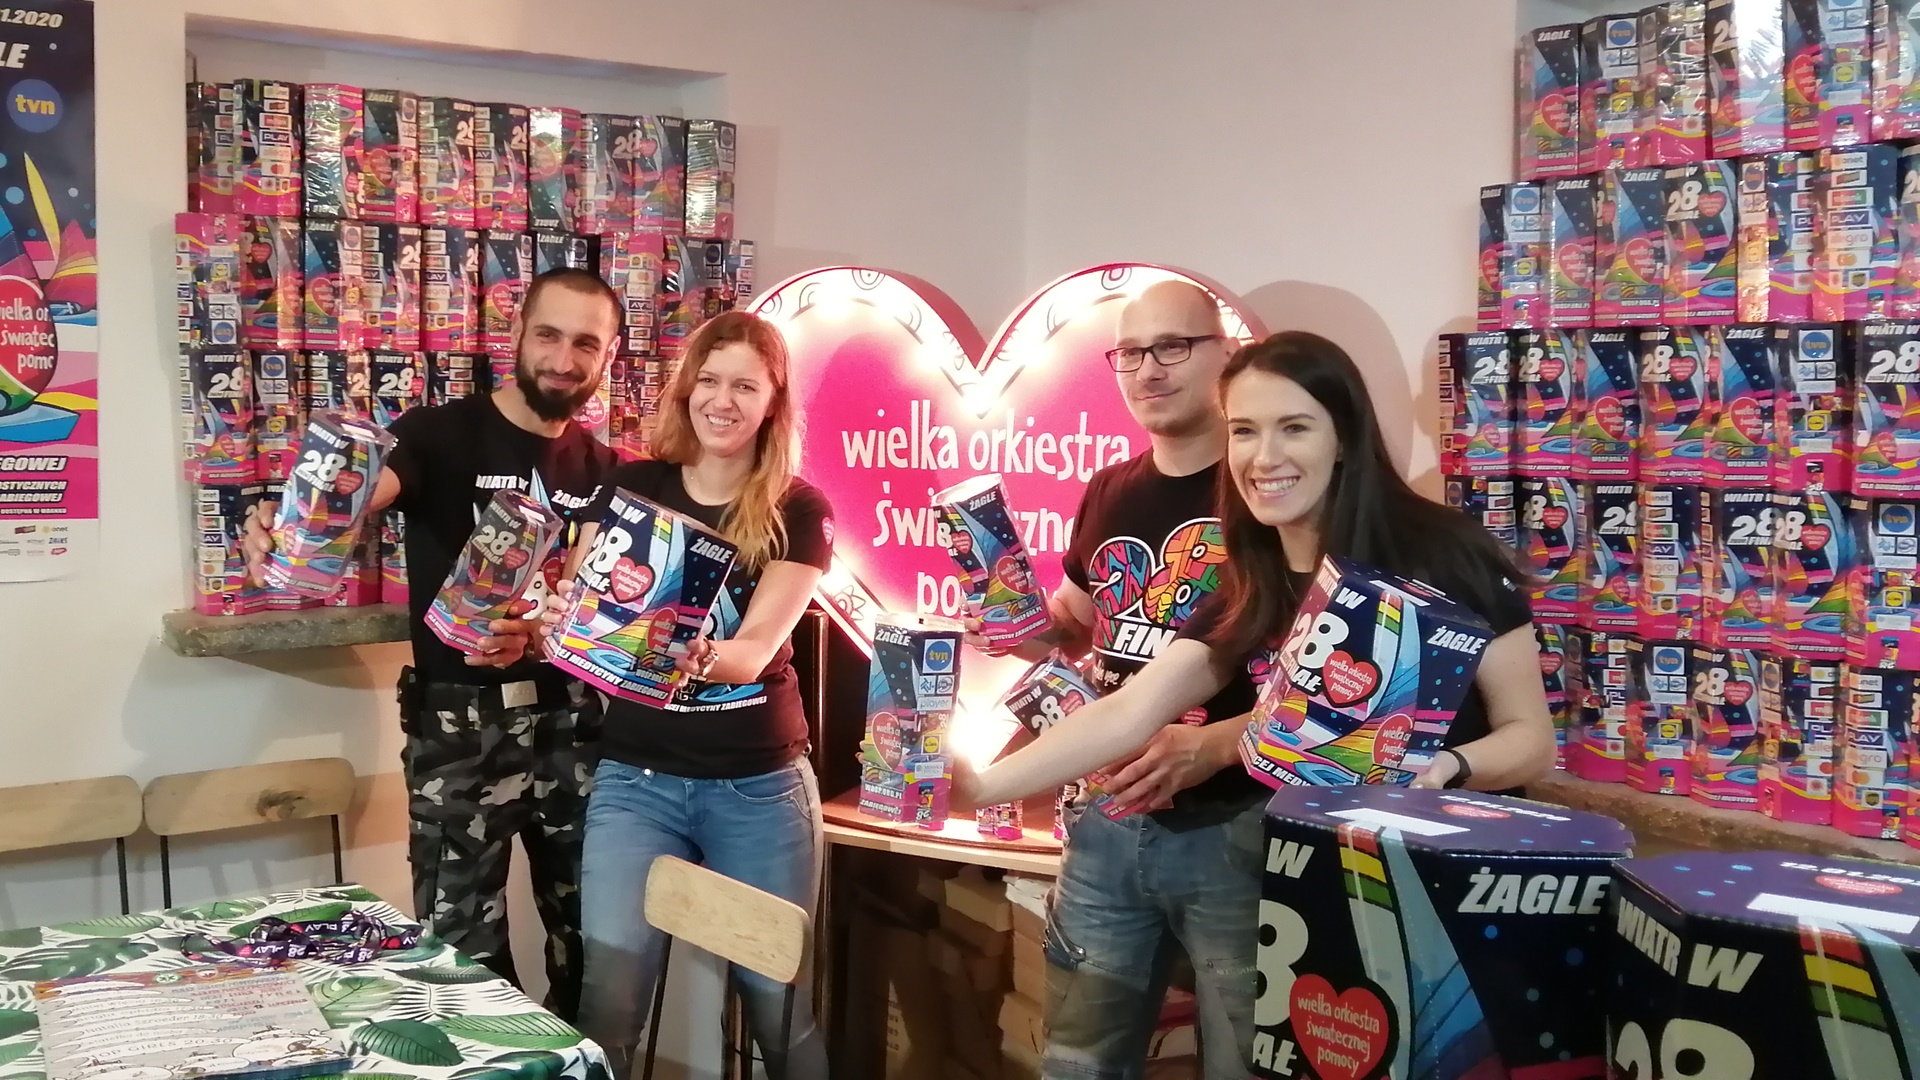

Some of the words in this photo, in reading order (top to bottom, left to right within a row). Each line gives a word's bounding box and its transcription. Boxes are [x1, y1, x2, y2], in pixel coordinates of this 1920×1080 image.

[1537, 29, 1572, 42] ŻAGLE
[15, 94, 56, 115] tvn
[263, 132, 289, 142] PLAY
[1556, 179, 1591, 190] ŻAGLE
[1623, 171, 1660, 182] ŻAGLE
[1831, 213, 1866, 224] PLAY
[0, 297, 33, 320] ielka
[1591, 332, 1626, 343] ŻAGLE
[1726, 328, 1766, 340] ŻAGLE
[1864, 323, 1905, 335] WIATR
[1805, 340, 1828, 349] tvn
[1865, 340, 1920, 382] 28
[378, 367, 415, 396] 28
[841, 399, 959, 470] wielka
[968, 407, 1130, 482] orkiestra
[0, 457, 67, 471] GOWEJ
[296, 449, 348, 484] 28
[0, 481, 67, 490] STYCZNYCH
[475, 474, 517, 489] WIATR
[1596, 485, 1634, 495] WIATR
[969, 490, 998, 512] ŻAGLE
[1723, 493, 1763, 503] WIATR
[489, 501, 513, 525] WIATR
[509, 518, 522, 530] W
[622, 505, 647, 524] W
[1885, 514, 1908, 523] tvn
[471, 525, 518, 558] 28
[690, 537, 733, 564] ŻAGLE
[1335, 587, 1367, 610] W
[875, 628, 912, 647] ŻAGLE
[1281, 611, 1350, 669] 28
[1427, 625, 1487, 655] ŻAGLE
[929, 649, 949, 661] tvn
[1658, 656, 1679, 665] tvn
[1329, 658, 1349, 672] wielka
[568, 656, 623, 687] MEDYCYNY
[620, 679, 669, 701] ZABIEGOWEJ
[1009, 693, 1032, 714] WIATR
[1030, 685, 1043, 701] W
[1331, 682, 1355, 700] pomocy
[679, 703, 721, 713] MEDYCYNY
[720, 695, 767, 711] ZABIEGOWEJ
[1382, 726, 1404, 740] wielka
[864, 783, 903, 800] WOSP.ORG.PL
[1265, 837, 1315, 879] W
[1457, 866, 1612, 915] ŻAGLE
[1617, 896, 1682, 977] WIATR
[1687, 943, 1764, 994] W
[1297, 992, 1332, 1018] wielka
[1333, 1000, 1380, 1034] orkiestra
[85, 1021, 131, 1035] Natalia
[128, 1041, 177, 1053] GIRLS
[1305, 1014, 1372, 1063] świątecznej
[1317, 1045, 1360, 1078] pomocy
